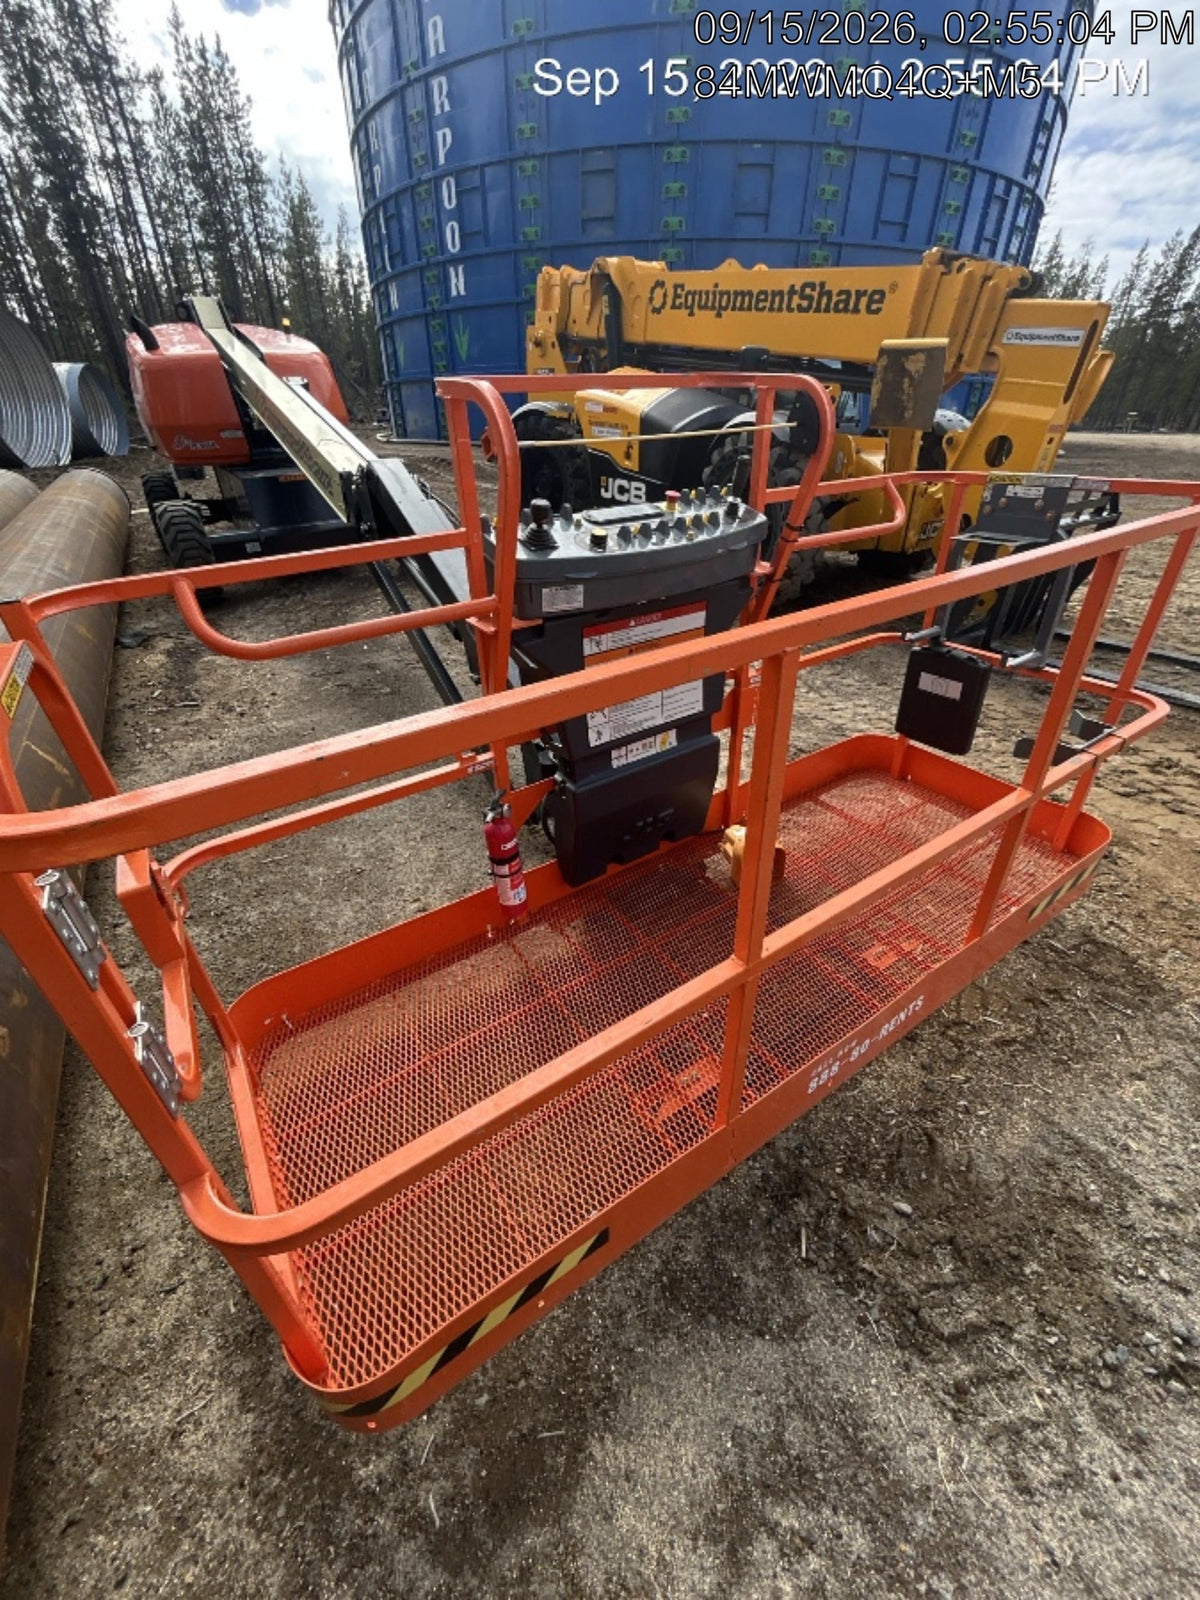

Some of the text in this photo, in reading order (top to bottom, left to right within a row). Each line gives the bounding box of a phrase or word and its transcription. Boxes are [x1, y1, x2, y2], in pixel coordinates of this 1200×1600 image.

[426, 0, 466, 297] ARPOON
[670, 280, 887, 318] EquipmentShare
[600, 477, 647, 503] JCB
